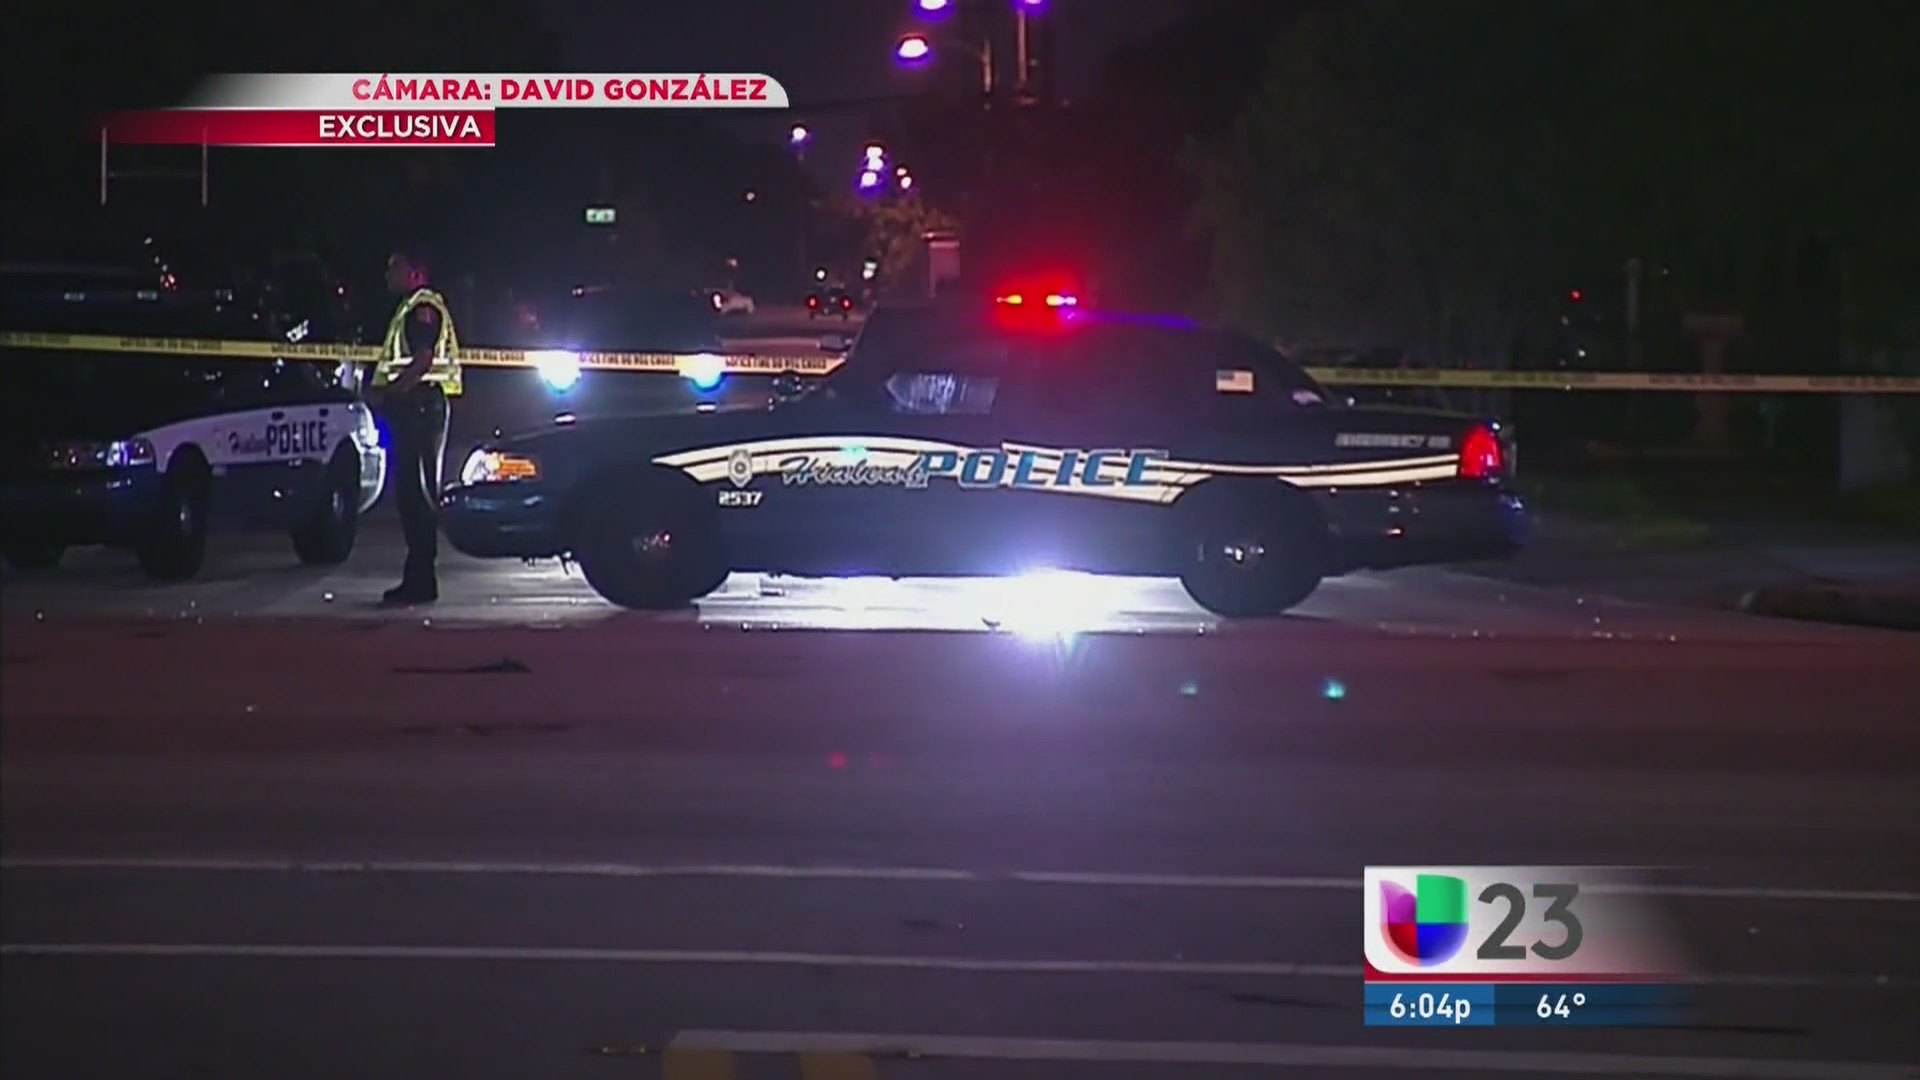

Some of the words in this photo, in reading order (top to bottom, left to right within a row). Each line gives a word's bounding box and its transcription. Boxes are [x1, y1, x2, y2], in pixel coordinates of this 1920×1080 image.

[266, 421, 327, 456] POLICE
[904, 448, 1168, 488] POLICE
[718, 491, 763, 506] 2537
